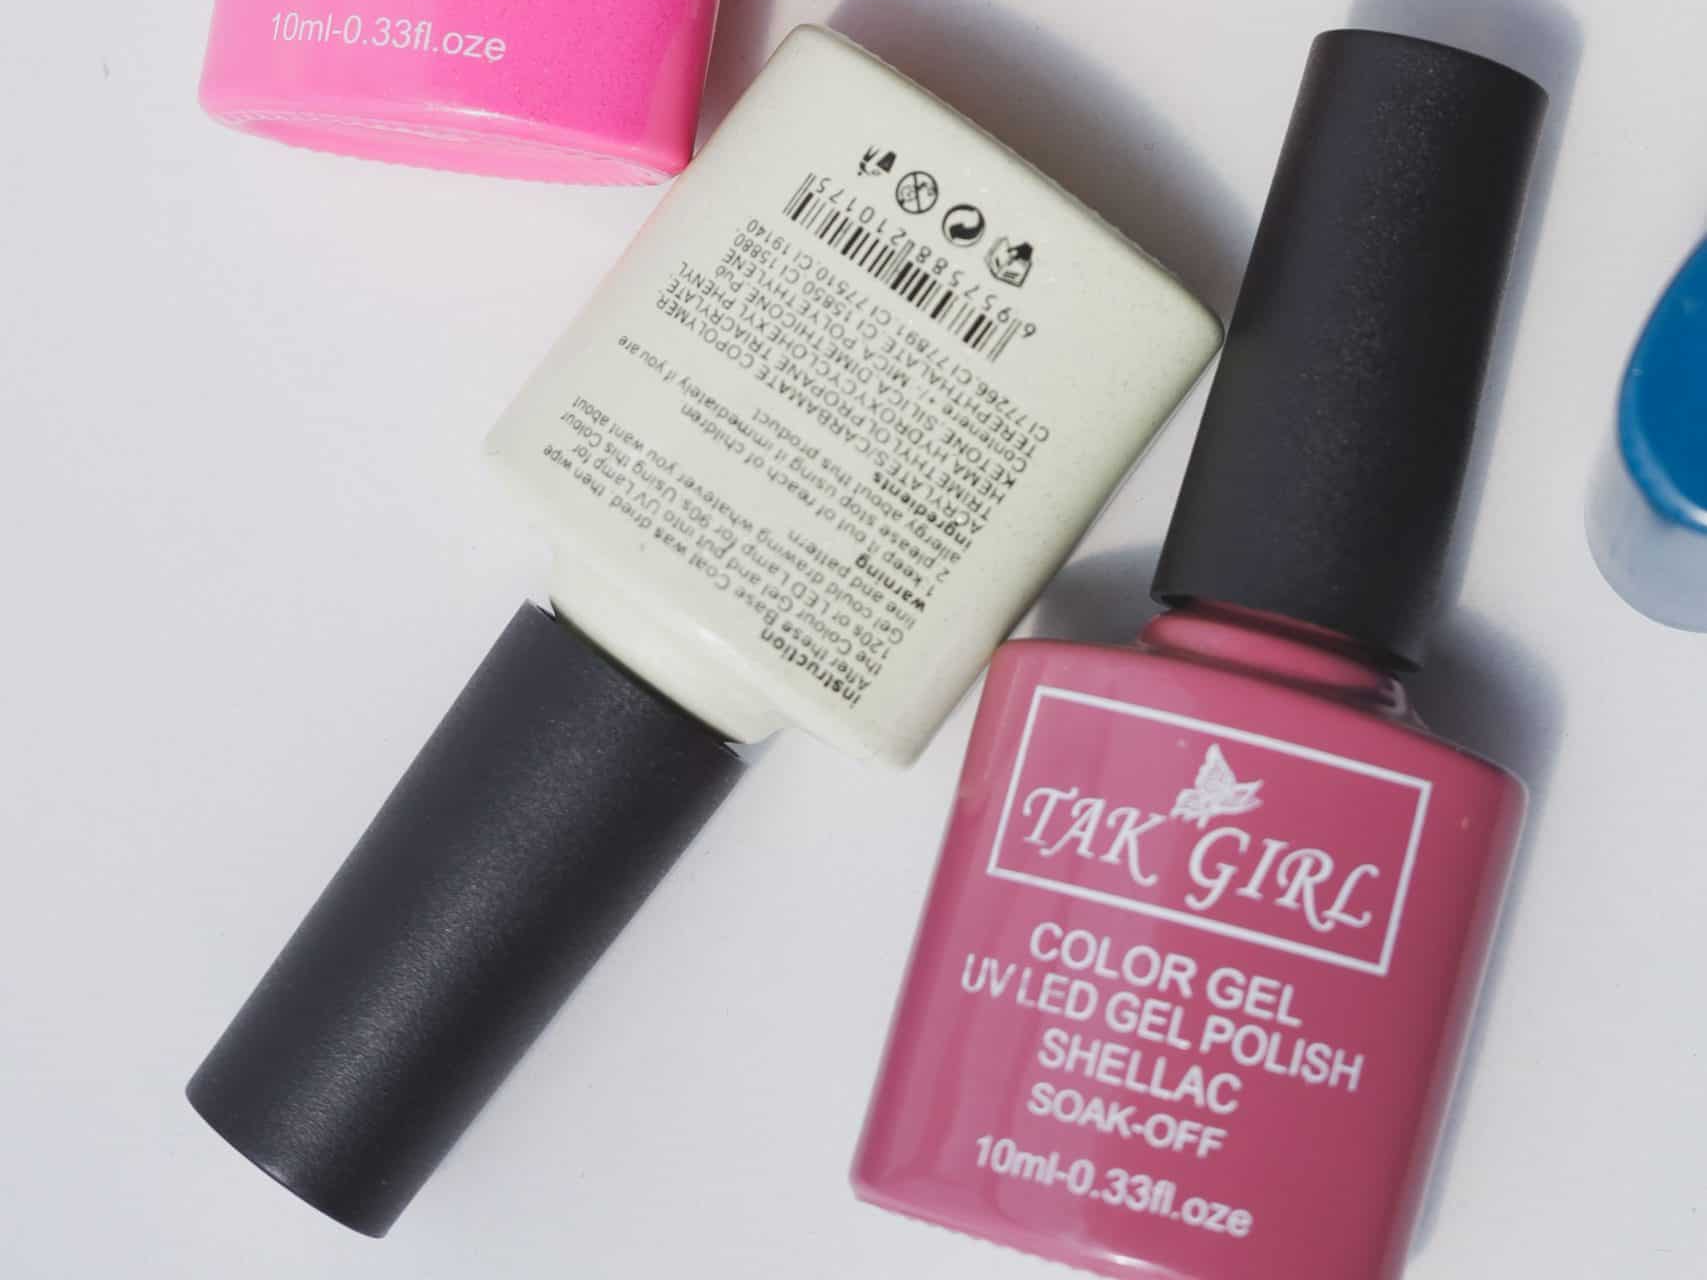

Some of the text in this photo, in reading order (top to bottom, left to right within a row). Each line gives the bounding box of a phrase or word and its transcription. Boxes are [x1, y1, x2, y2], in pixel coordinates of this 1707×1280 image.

[271, 12, 506, 63] 10ml-0.33fl.oze
[617, 335, 641, 355] are
[637, 349, 668, 374] you
[559, 410, 603, 448] Colour
[571, 394, 610, 430] about
[541, 443, 573, 472] wipe
[569, 443, 592, 465] for
[641, 448, 678, 476] you
[572, 466, 607, 498] then
[590, 456, 636, 496] Lamp
[630, 490, 661, 516] UV
[674, 472, 754, 534] whatever
[871, 466, 973, 552] ingredients
[652, 525, 688, 556] was
[754, 527, 826, 586] drawing
[687, 551, 731, 591] Coat
[724, 556, 762, 587] and
[847, 574, 885, 604] and
[852, 551, 927, 614] warning
[732, 585, 780, 627] Base
[759, 583, 794, 613] Gel
[789, 580, 831, 616] LED
[823, 580, 873, 620] could
[780, 619, 829, 662] these
[793, 604, 853, 656] Colour
[871, 615, 904, 645] Gel
[758, 624, 862, 709] instruction
[828, 656, 872, 692] After
[853, 649, 883, 677] the
[1022, 786, 1379, 932] TAK GIRL
[1030, 922, 1302, 1027] COLOR GEL
[961, 953, 1363, 1092] UV LED GEL POLISH
[1038, 1028, 1242, 1114] SHELLAC
[1027, 1082, 1227, 1158] SOAK-OFF
[975, 1134, 1253, 1237] 10ml-0.33fl.oze
